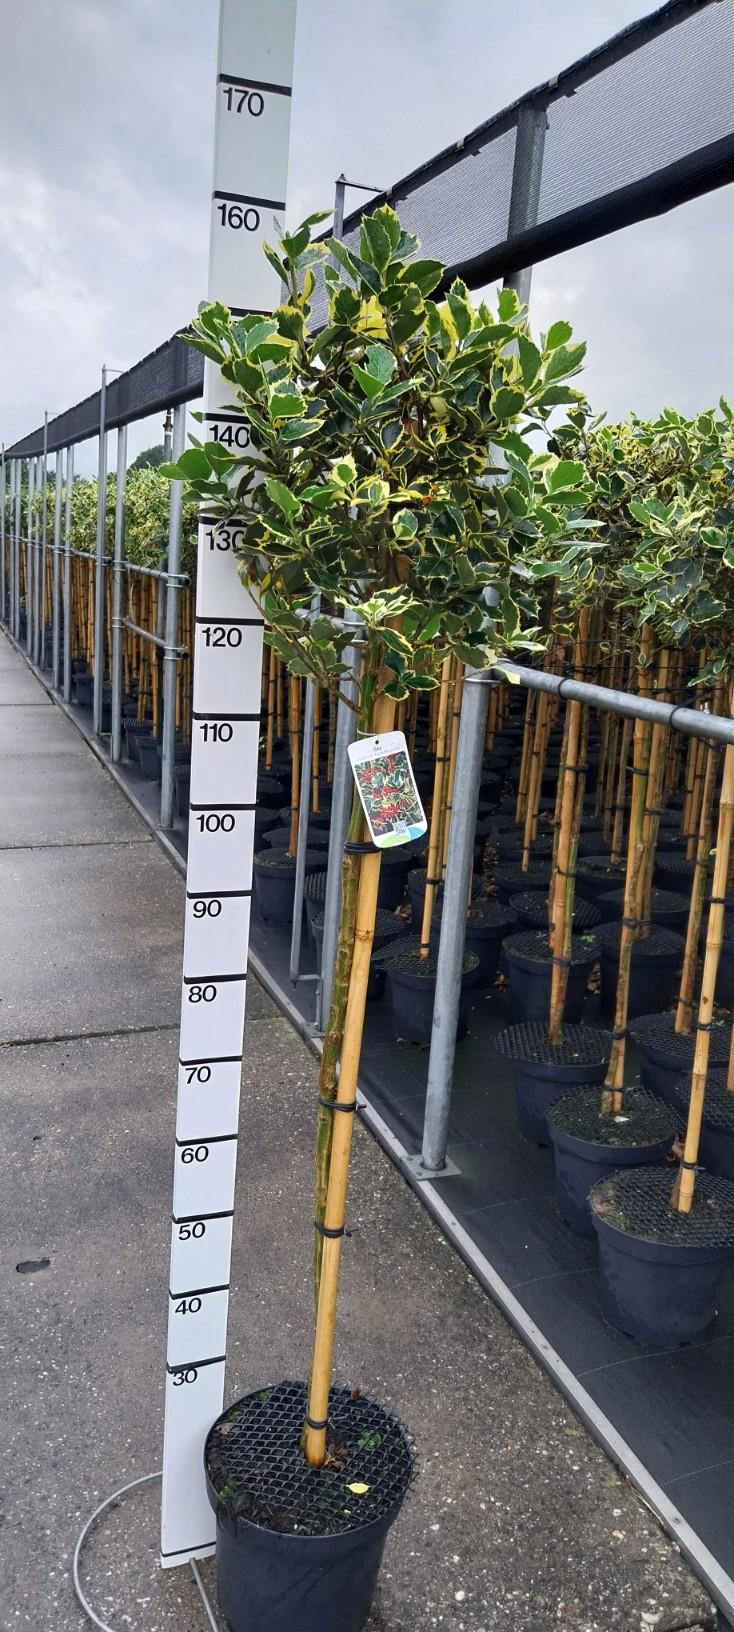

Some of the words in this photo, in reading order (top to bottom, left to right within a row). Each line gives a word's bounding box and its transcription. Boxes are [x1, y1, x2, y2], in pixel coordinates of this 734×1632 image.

[223, 86, 265, 117] 170
[217, 203, 261, 232] 160
[209, 424, 251, 449] 140
[201, 626, 243, 648] 120
[199, 722, 234, 743] 110
[196, 813, 236, 833] 100
[192, 899, 222, 918] 90
[188, 984, 217, 1004] 80
[185, 1065, 212, 1085] 70
[180, 1145, 209, 1164] 60
[178, 1221, 206, 1241] 50
[174, 1297, 202, 1316] 40
[172, 1368, 198, 1387] 30
